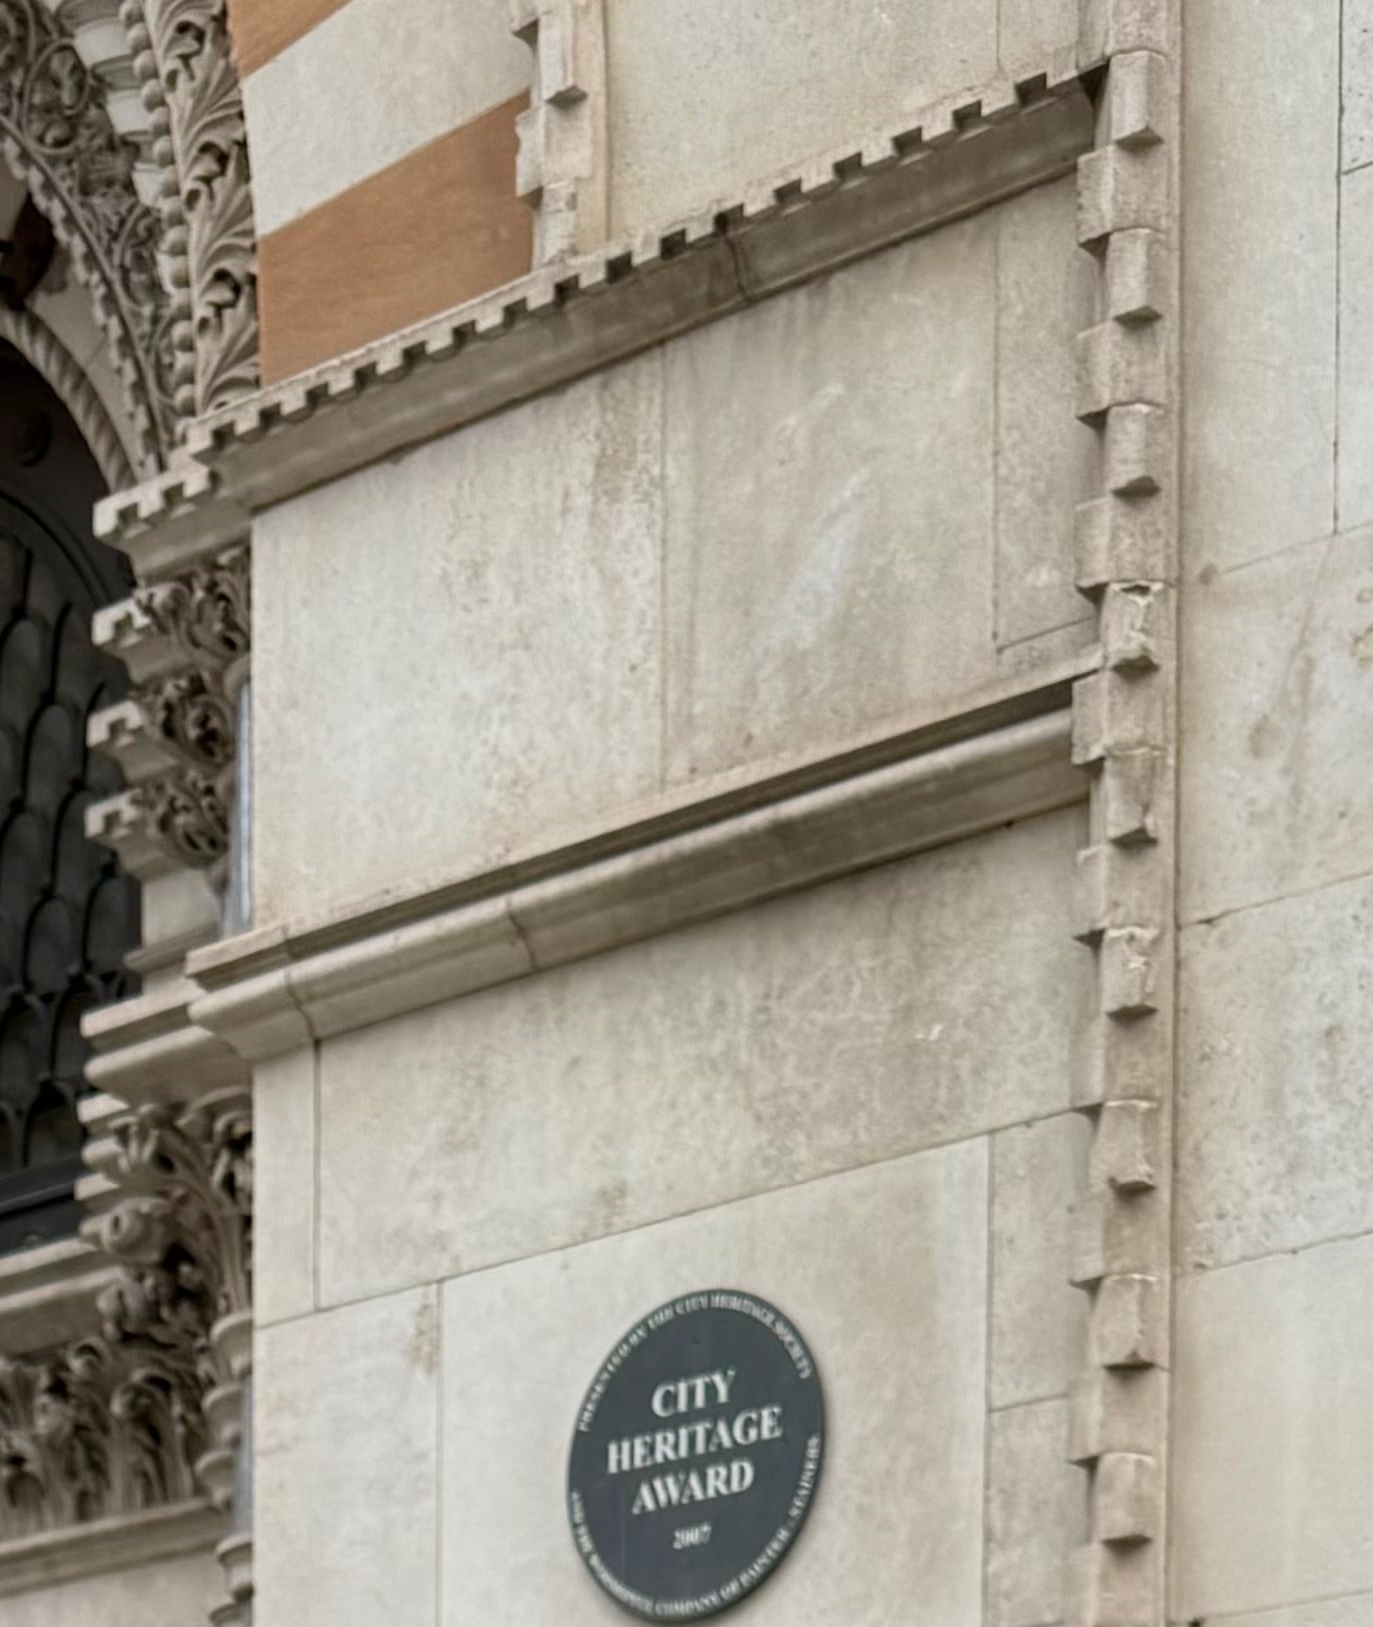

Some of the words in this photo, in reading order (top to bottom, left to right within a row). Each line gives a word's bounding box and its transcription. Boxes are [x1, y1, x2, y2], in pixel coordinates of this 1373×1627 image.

[675, 1295, 708, 1315] CITY
[651, 1368, 737, 1418] CITY
[606, 1404, 783, 1475] HERITAGE
[631, 1457, 756, 1515] AWARD
[673, 1521, 713, 1550] 2007
